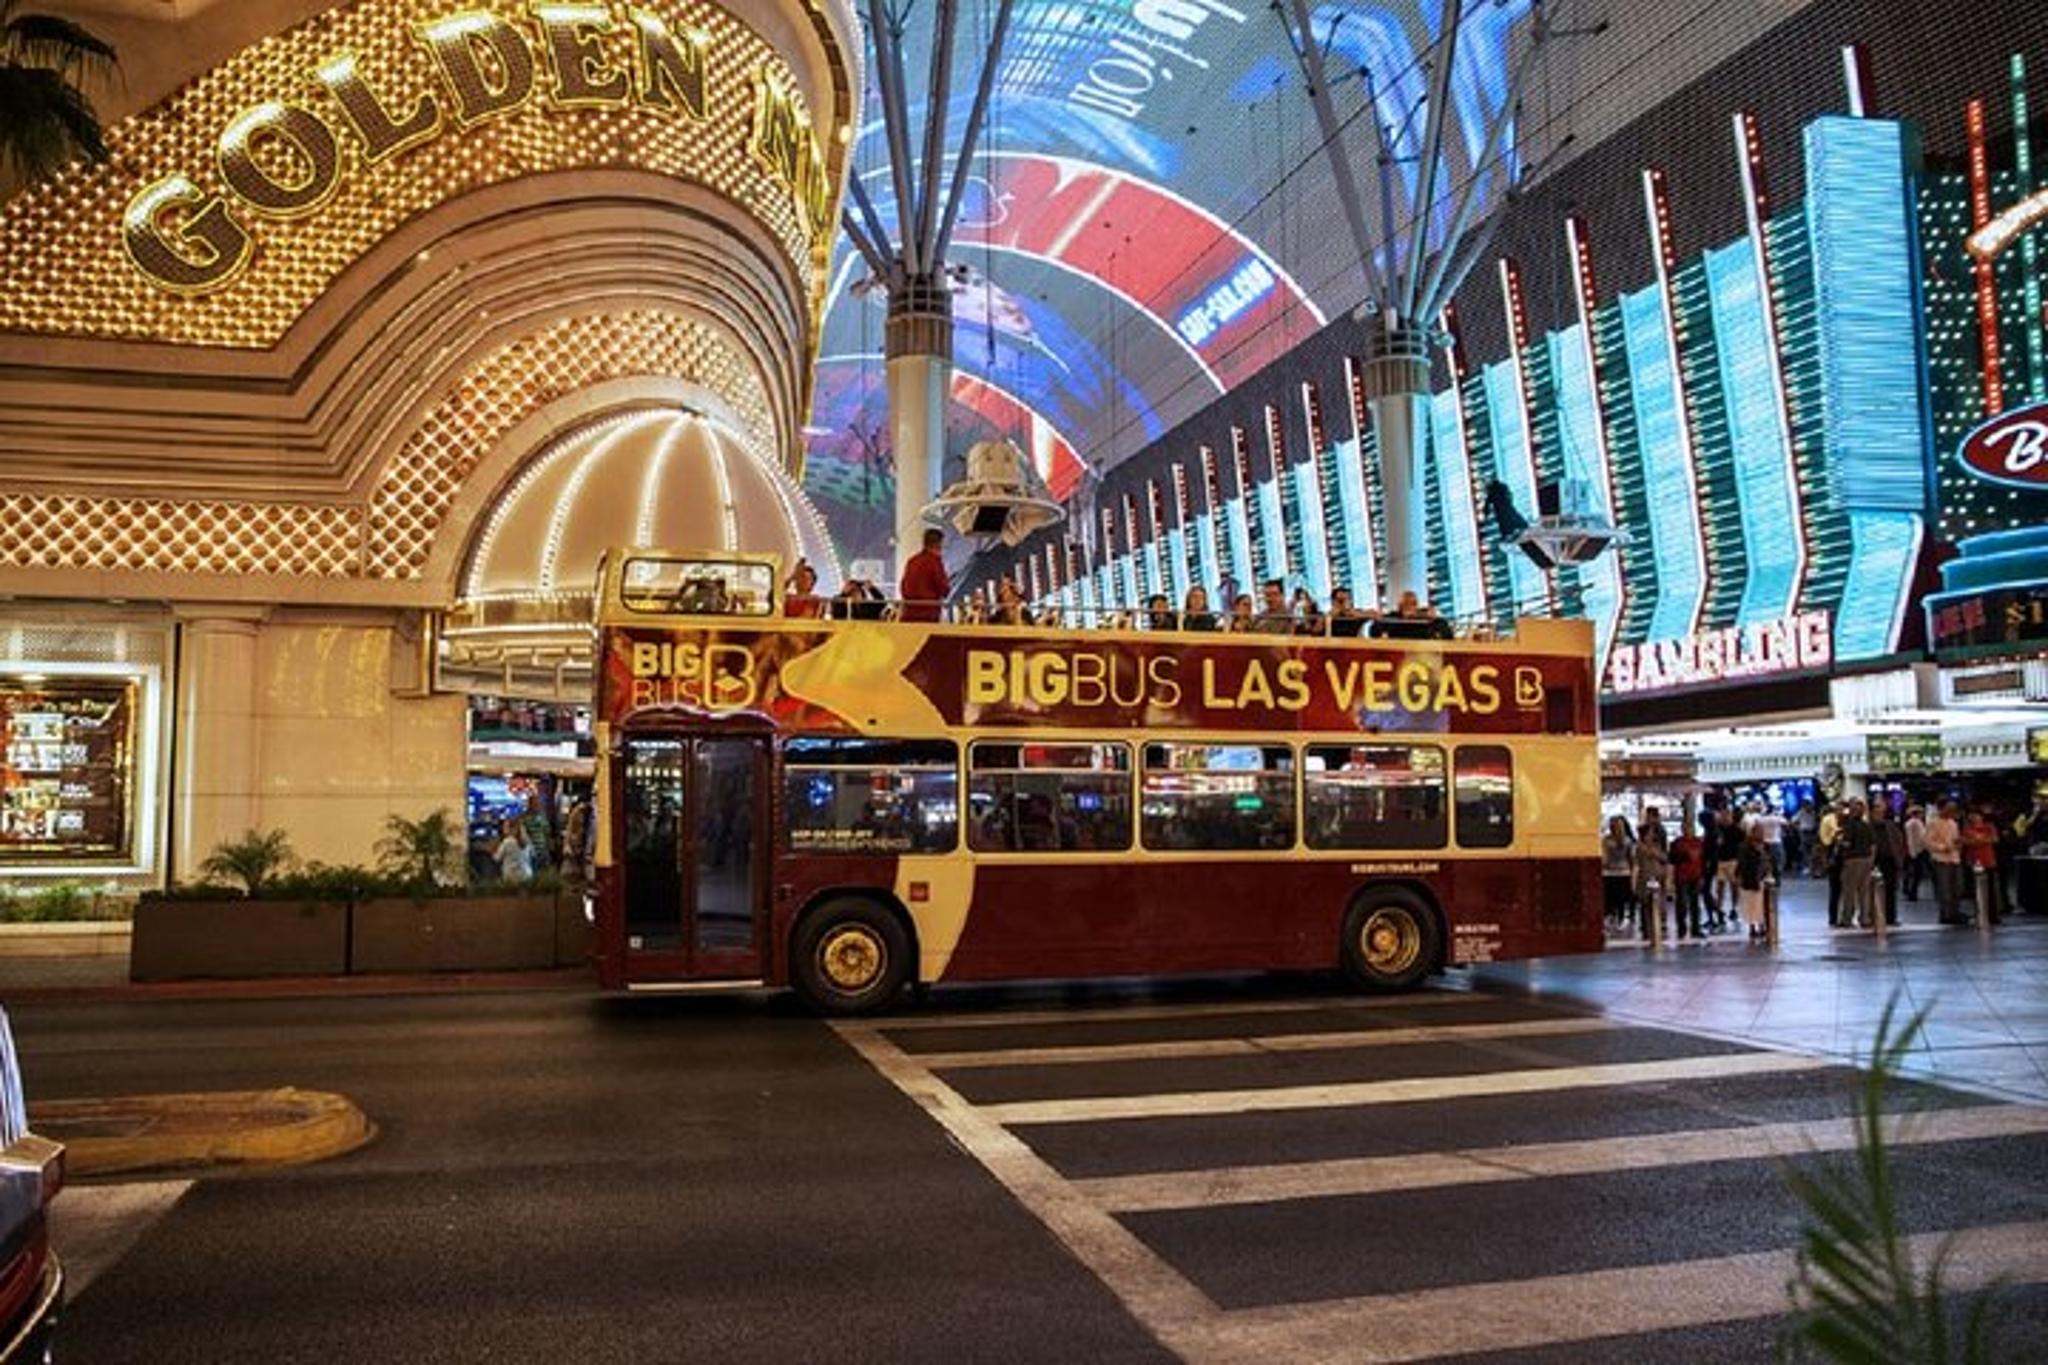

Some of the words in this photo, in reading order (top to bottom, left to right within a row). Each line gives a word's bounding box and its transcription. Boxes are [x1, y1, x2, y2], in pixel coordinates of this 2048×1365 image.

[121, 4, 711, 295] GOLDEN
[633, 642, 701, 677] BIG
[632, 679, 701, 711] BUS
[1202, 658, 1310, 710] LAS
[1325, 660, 1500, 714] VEGAS
